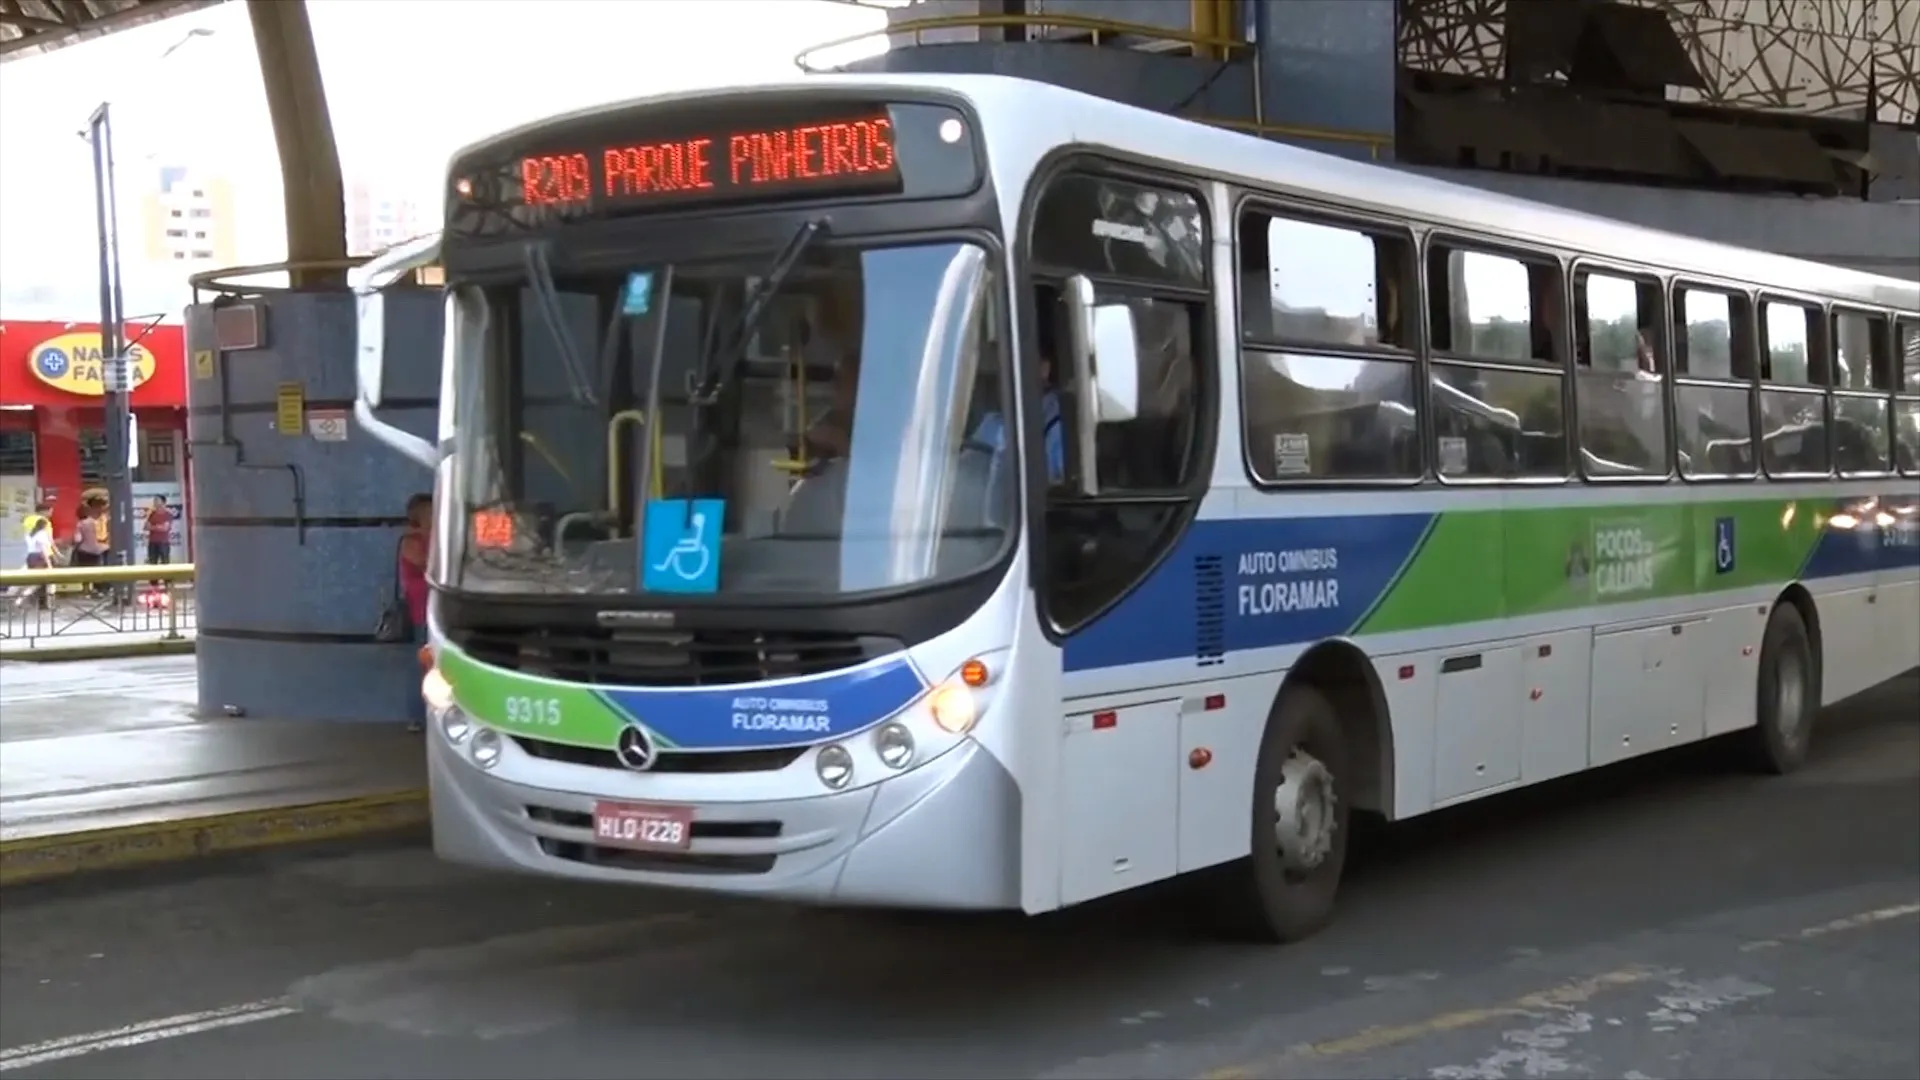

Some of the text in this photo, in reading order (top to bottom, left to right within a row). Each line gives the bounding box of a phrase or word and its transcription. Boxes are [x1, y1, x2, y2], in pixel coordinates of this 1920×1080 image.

[521, 118, 893, 205] R209 PARQUE PINHEIROS
[72, 346, 143, 362] NAS
[73, 365, 145, 381] FAA
[1596, 528, 1642, 559] POÇOS
[1238, 547, 1338, 575] AUTO OMNIBUS
[1238, 578, 1339, 616] FLORAMAR
[505, 695, 562, 727] 9315
[732, 697, 768, 711] AUTO
[732, 713, 831, 733] FLORAMAR
